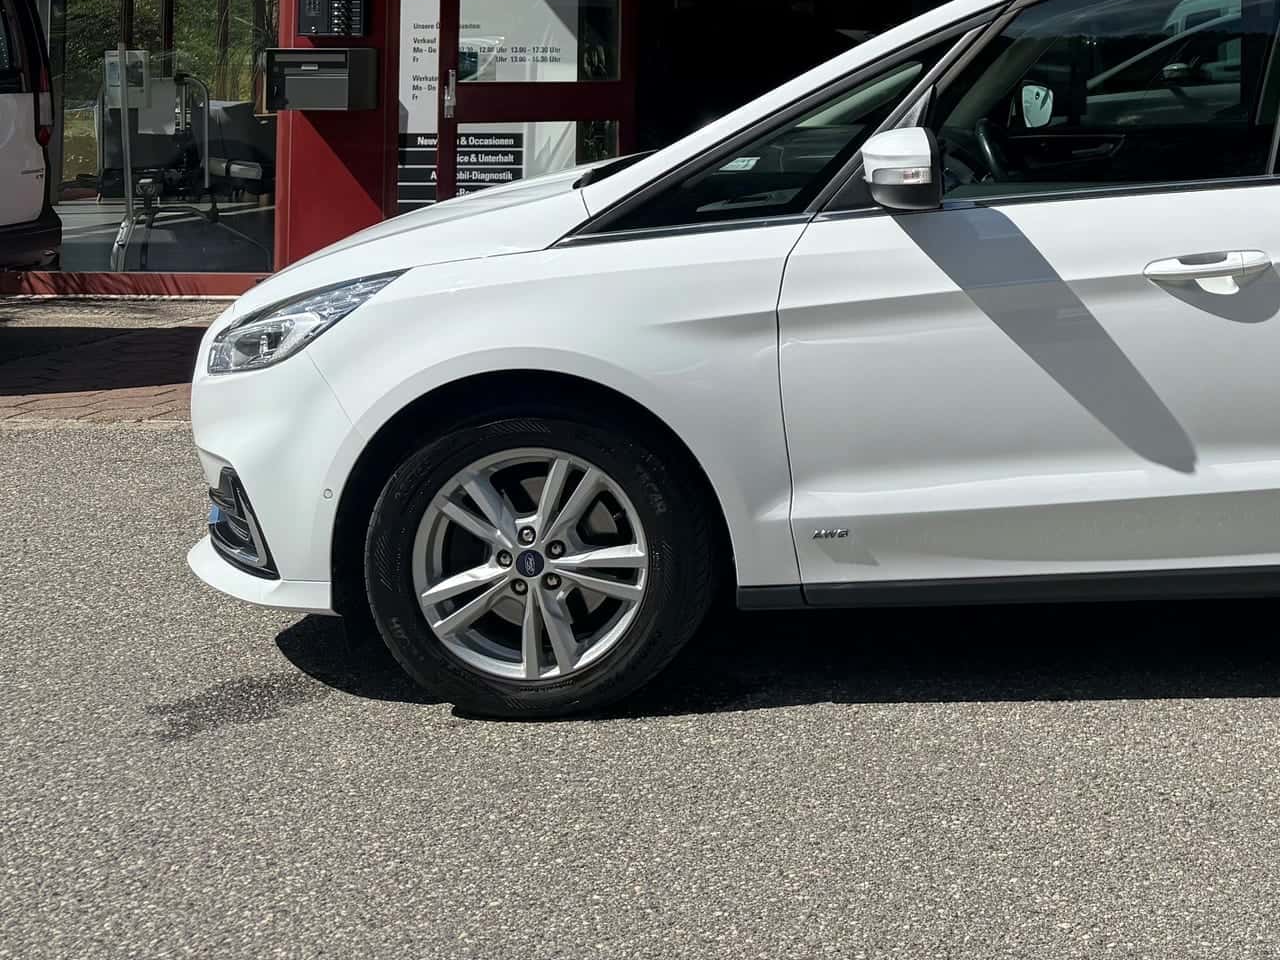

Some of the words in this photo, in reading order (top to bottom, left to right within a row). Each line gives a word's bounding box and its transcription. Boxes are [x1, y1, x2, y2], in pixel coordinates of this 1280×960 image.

[460, 136, 467, 145] &
[469, 136, 514, 145] Occasionen
[470, 154, 477, 162] &
[478, 154, 514, 163] Unterhalt
